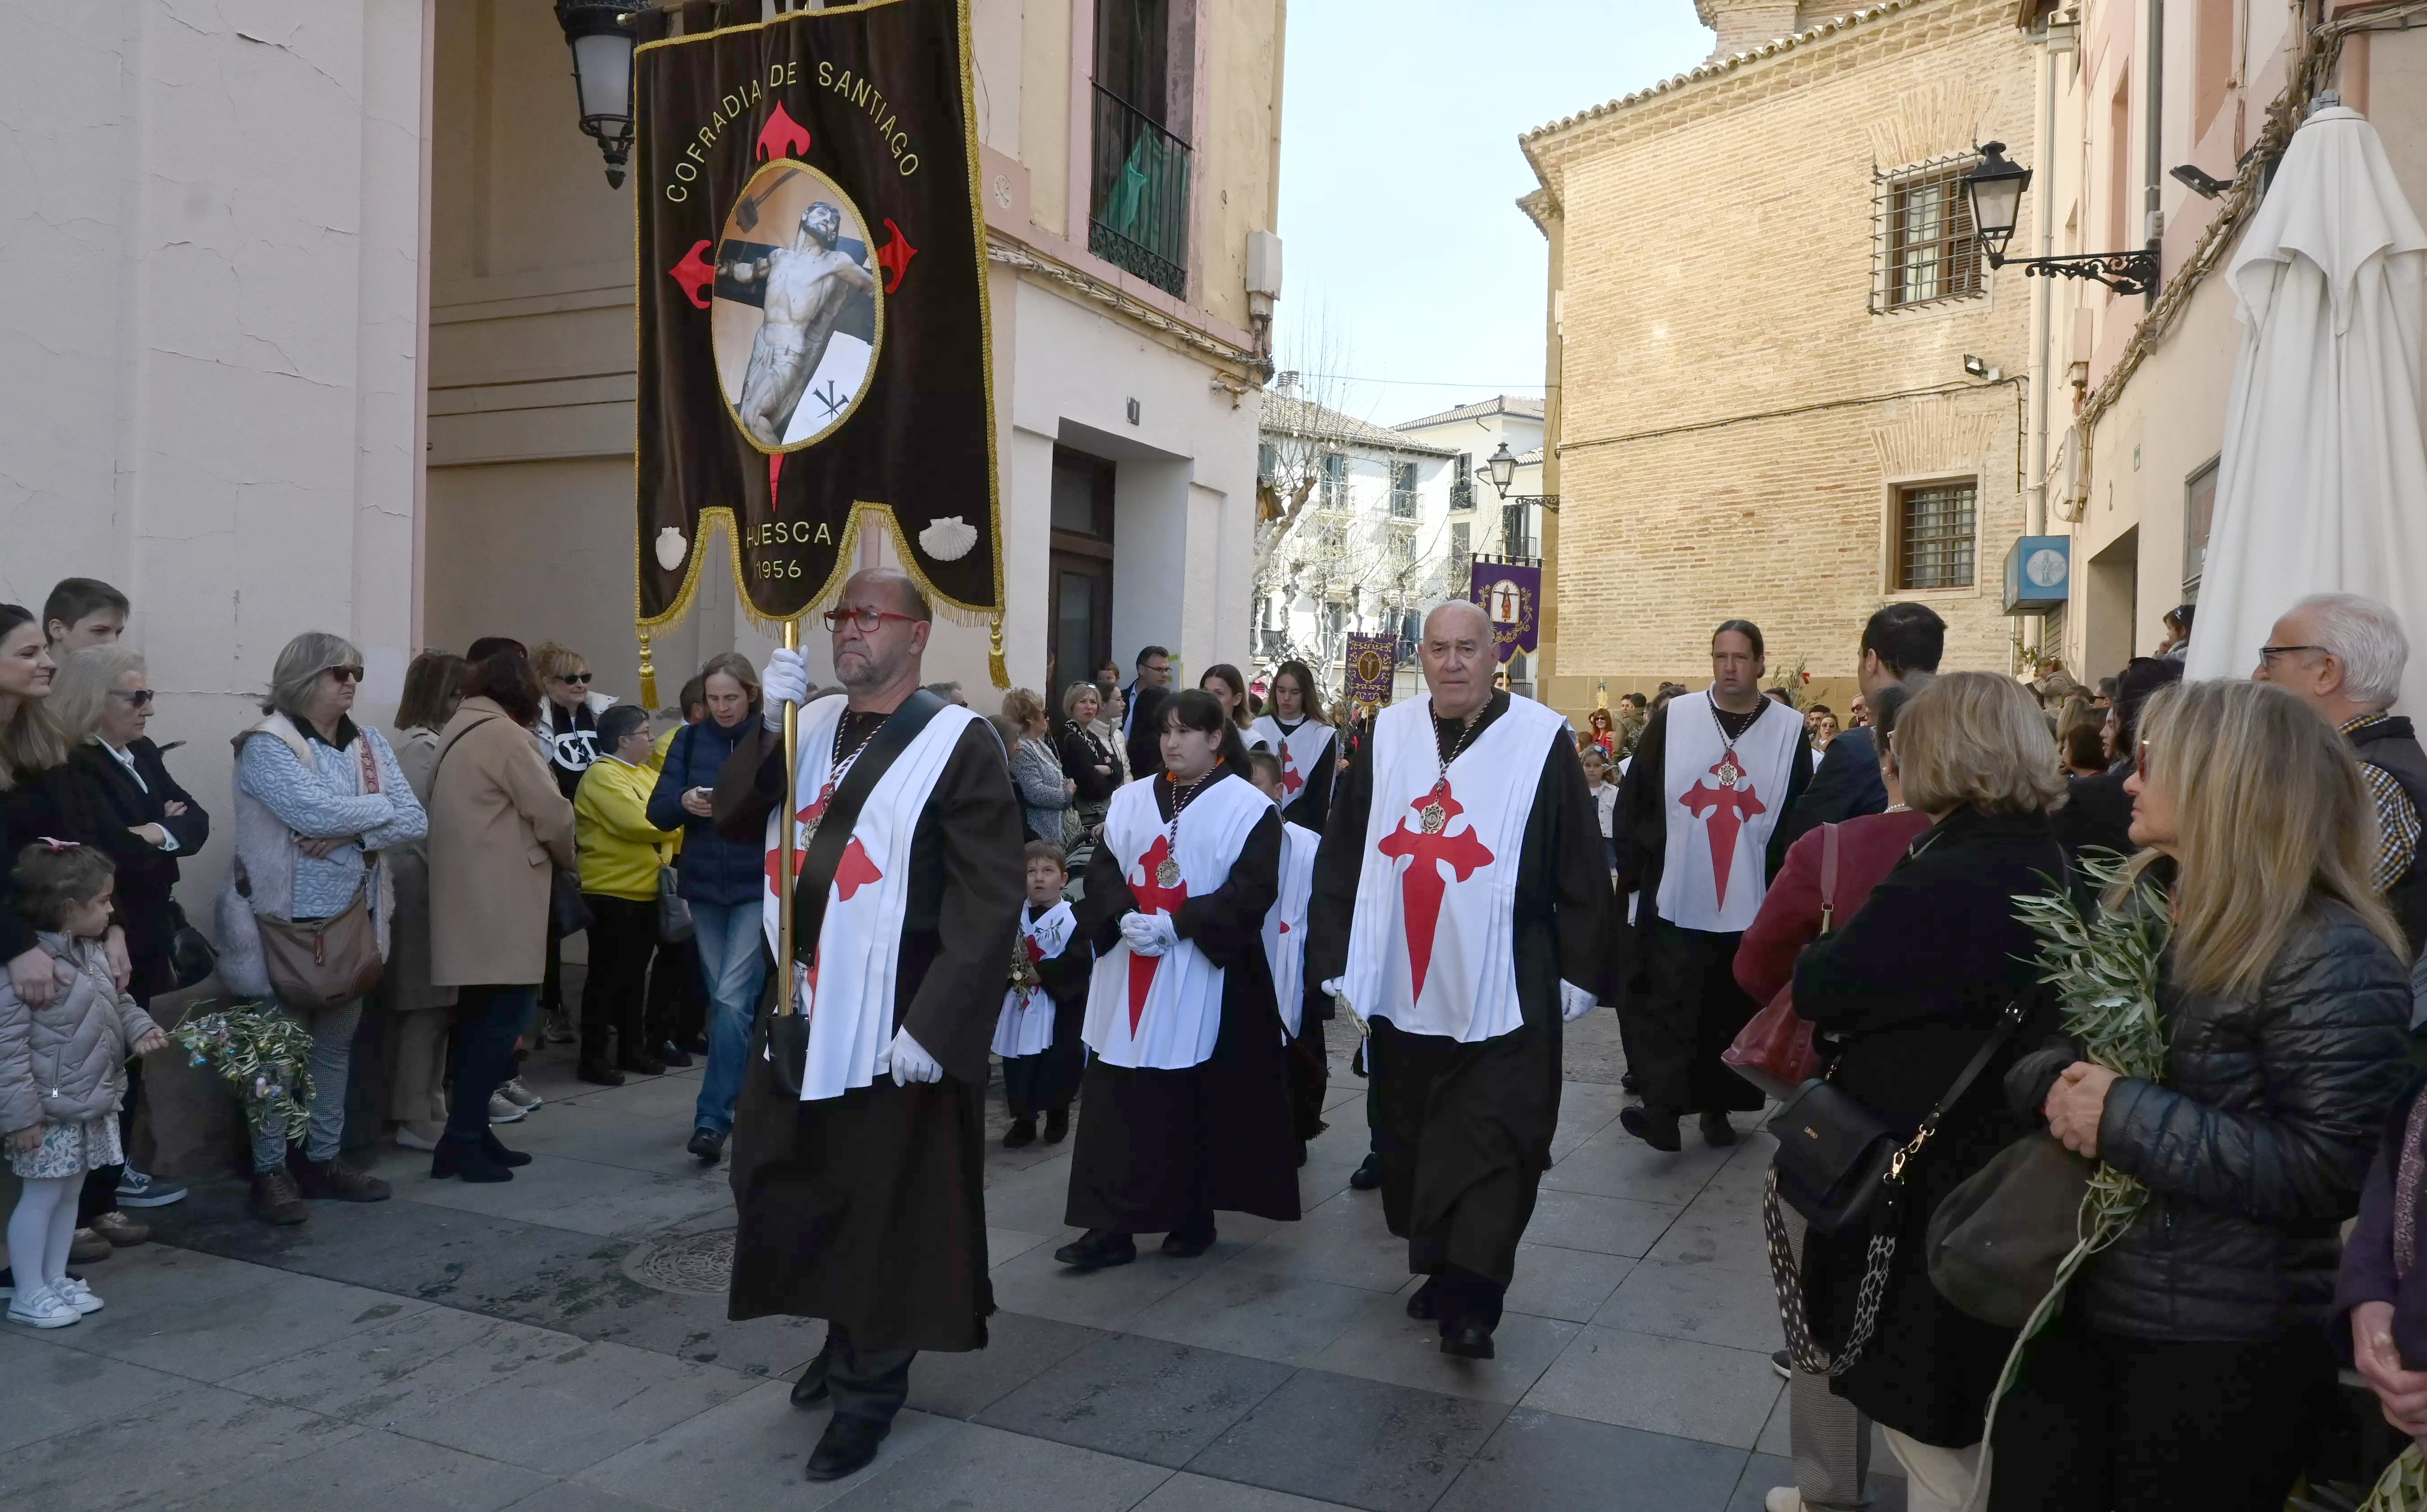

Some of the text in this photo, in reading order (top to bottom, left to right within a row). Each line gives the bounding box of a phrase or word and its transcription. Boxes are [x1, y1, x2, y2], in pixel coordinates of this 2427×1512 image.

[666, 61, 920, 203] COFRADIA DE SANTIAGO
[747, 521, 831, 548] HUESCA
[756, 559, 801, 579] 1956
